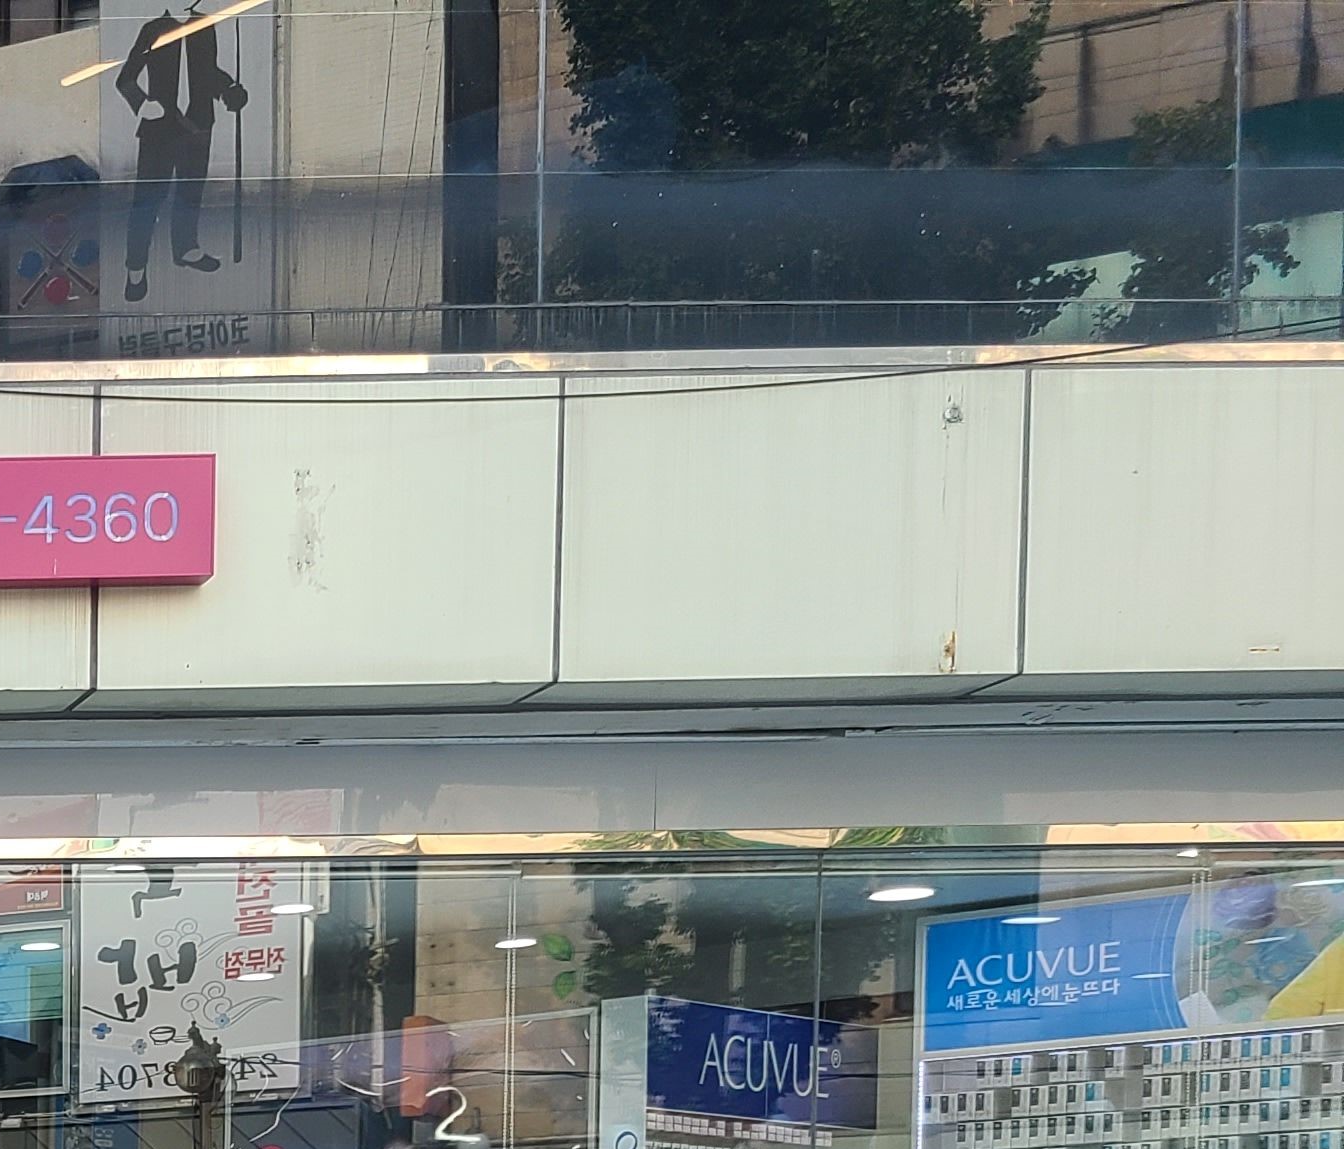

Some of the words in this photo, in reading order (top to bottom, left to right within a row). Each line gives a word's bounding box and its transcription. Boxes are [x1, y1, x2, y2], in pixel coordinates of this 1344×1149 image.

[947, 940, 1122, 990] ACUVUE
[947, 988, 1002, 1011] 새로운
[1004, 981, 1060, 1006] 세상에
